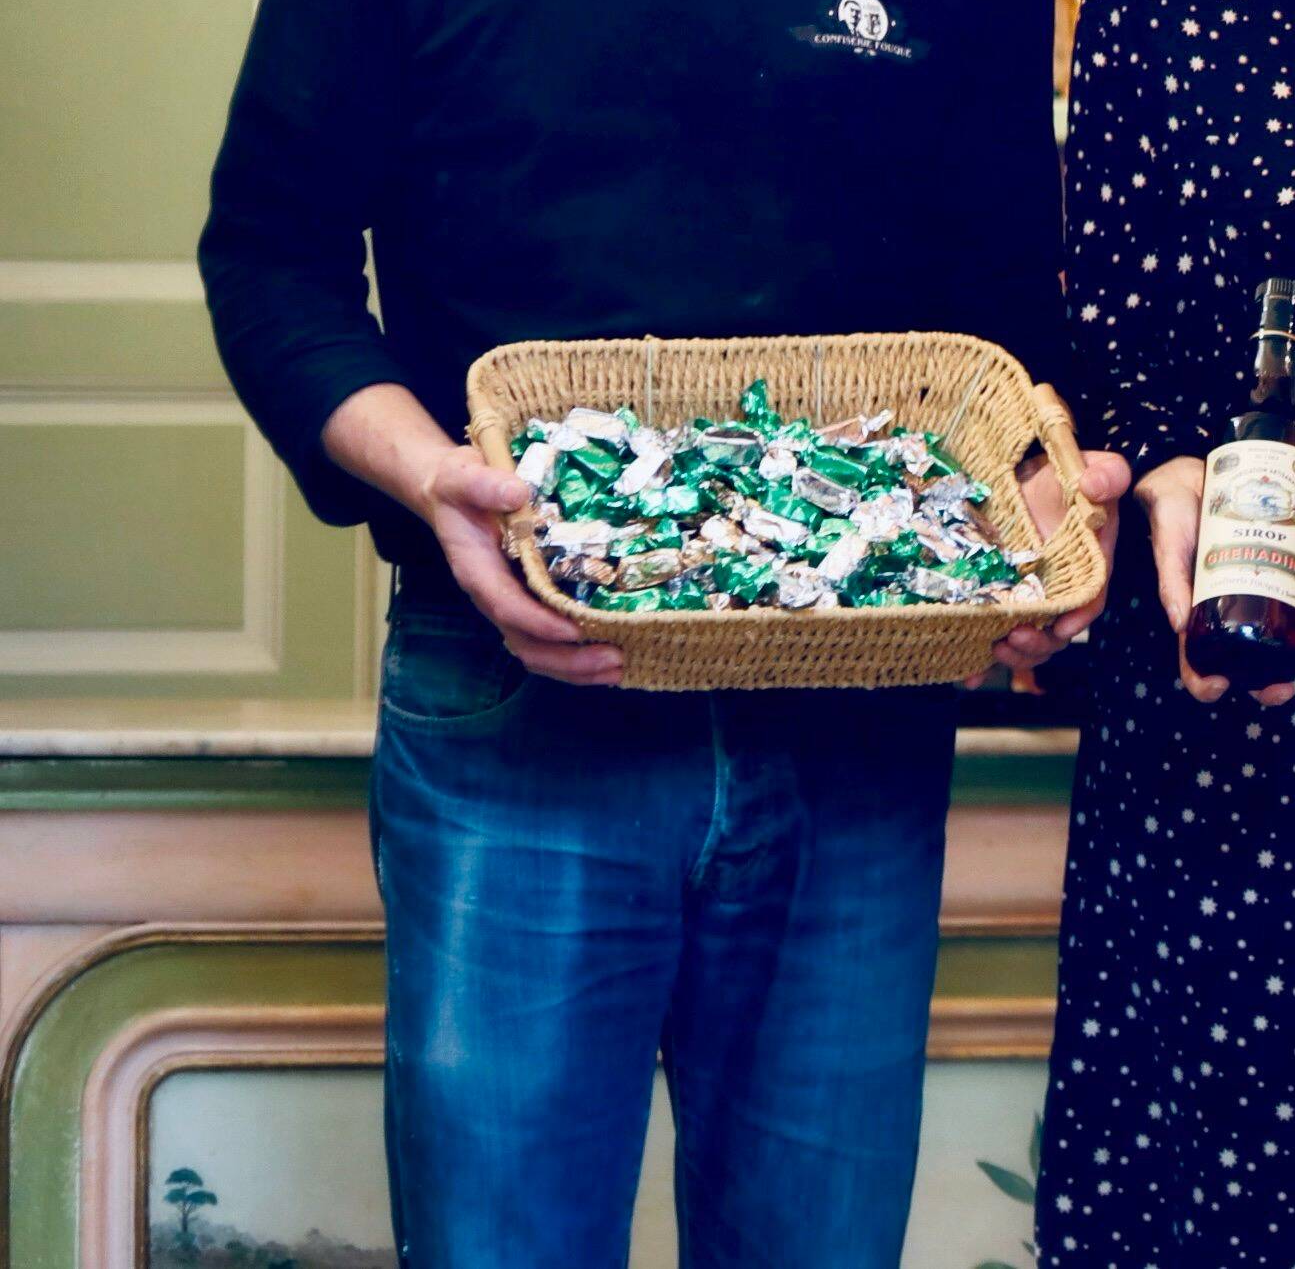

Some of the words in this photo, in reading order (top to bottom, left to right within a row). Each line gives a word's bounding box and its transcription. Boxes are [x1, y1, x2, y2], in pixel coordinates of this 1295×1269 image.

[814, 33, 871, 48] CONFISERIE
[874, 40, 912, 58] FOUQUE
[1233, 528, 1287, 541] SIROP
